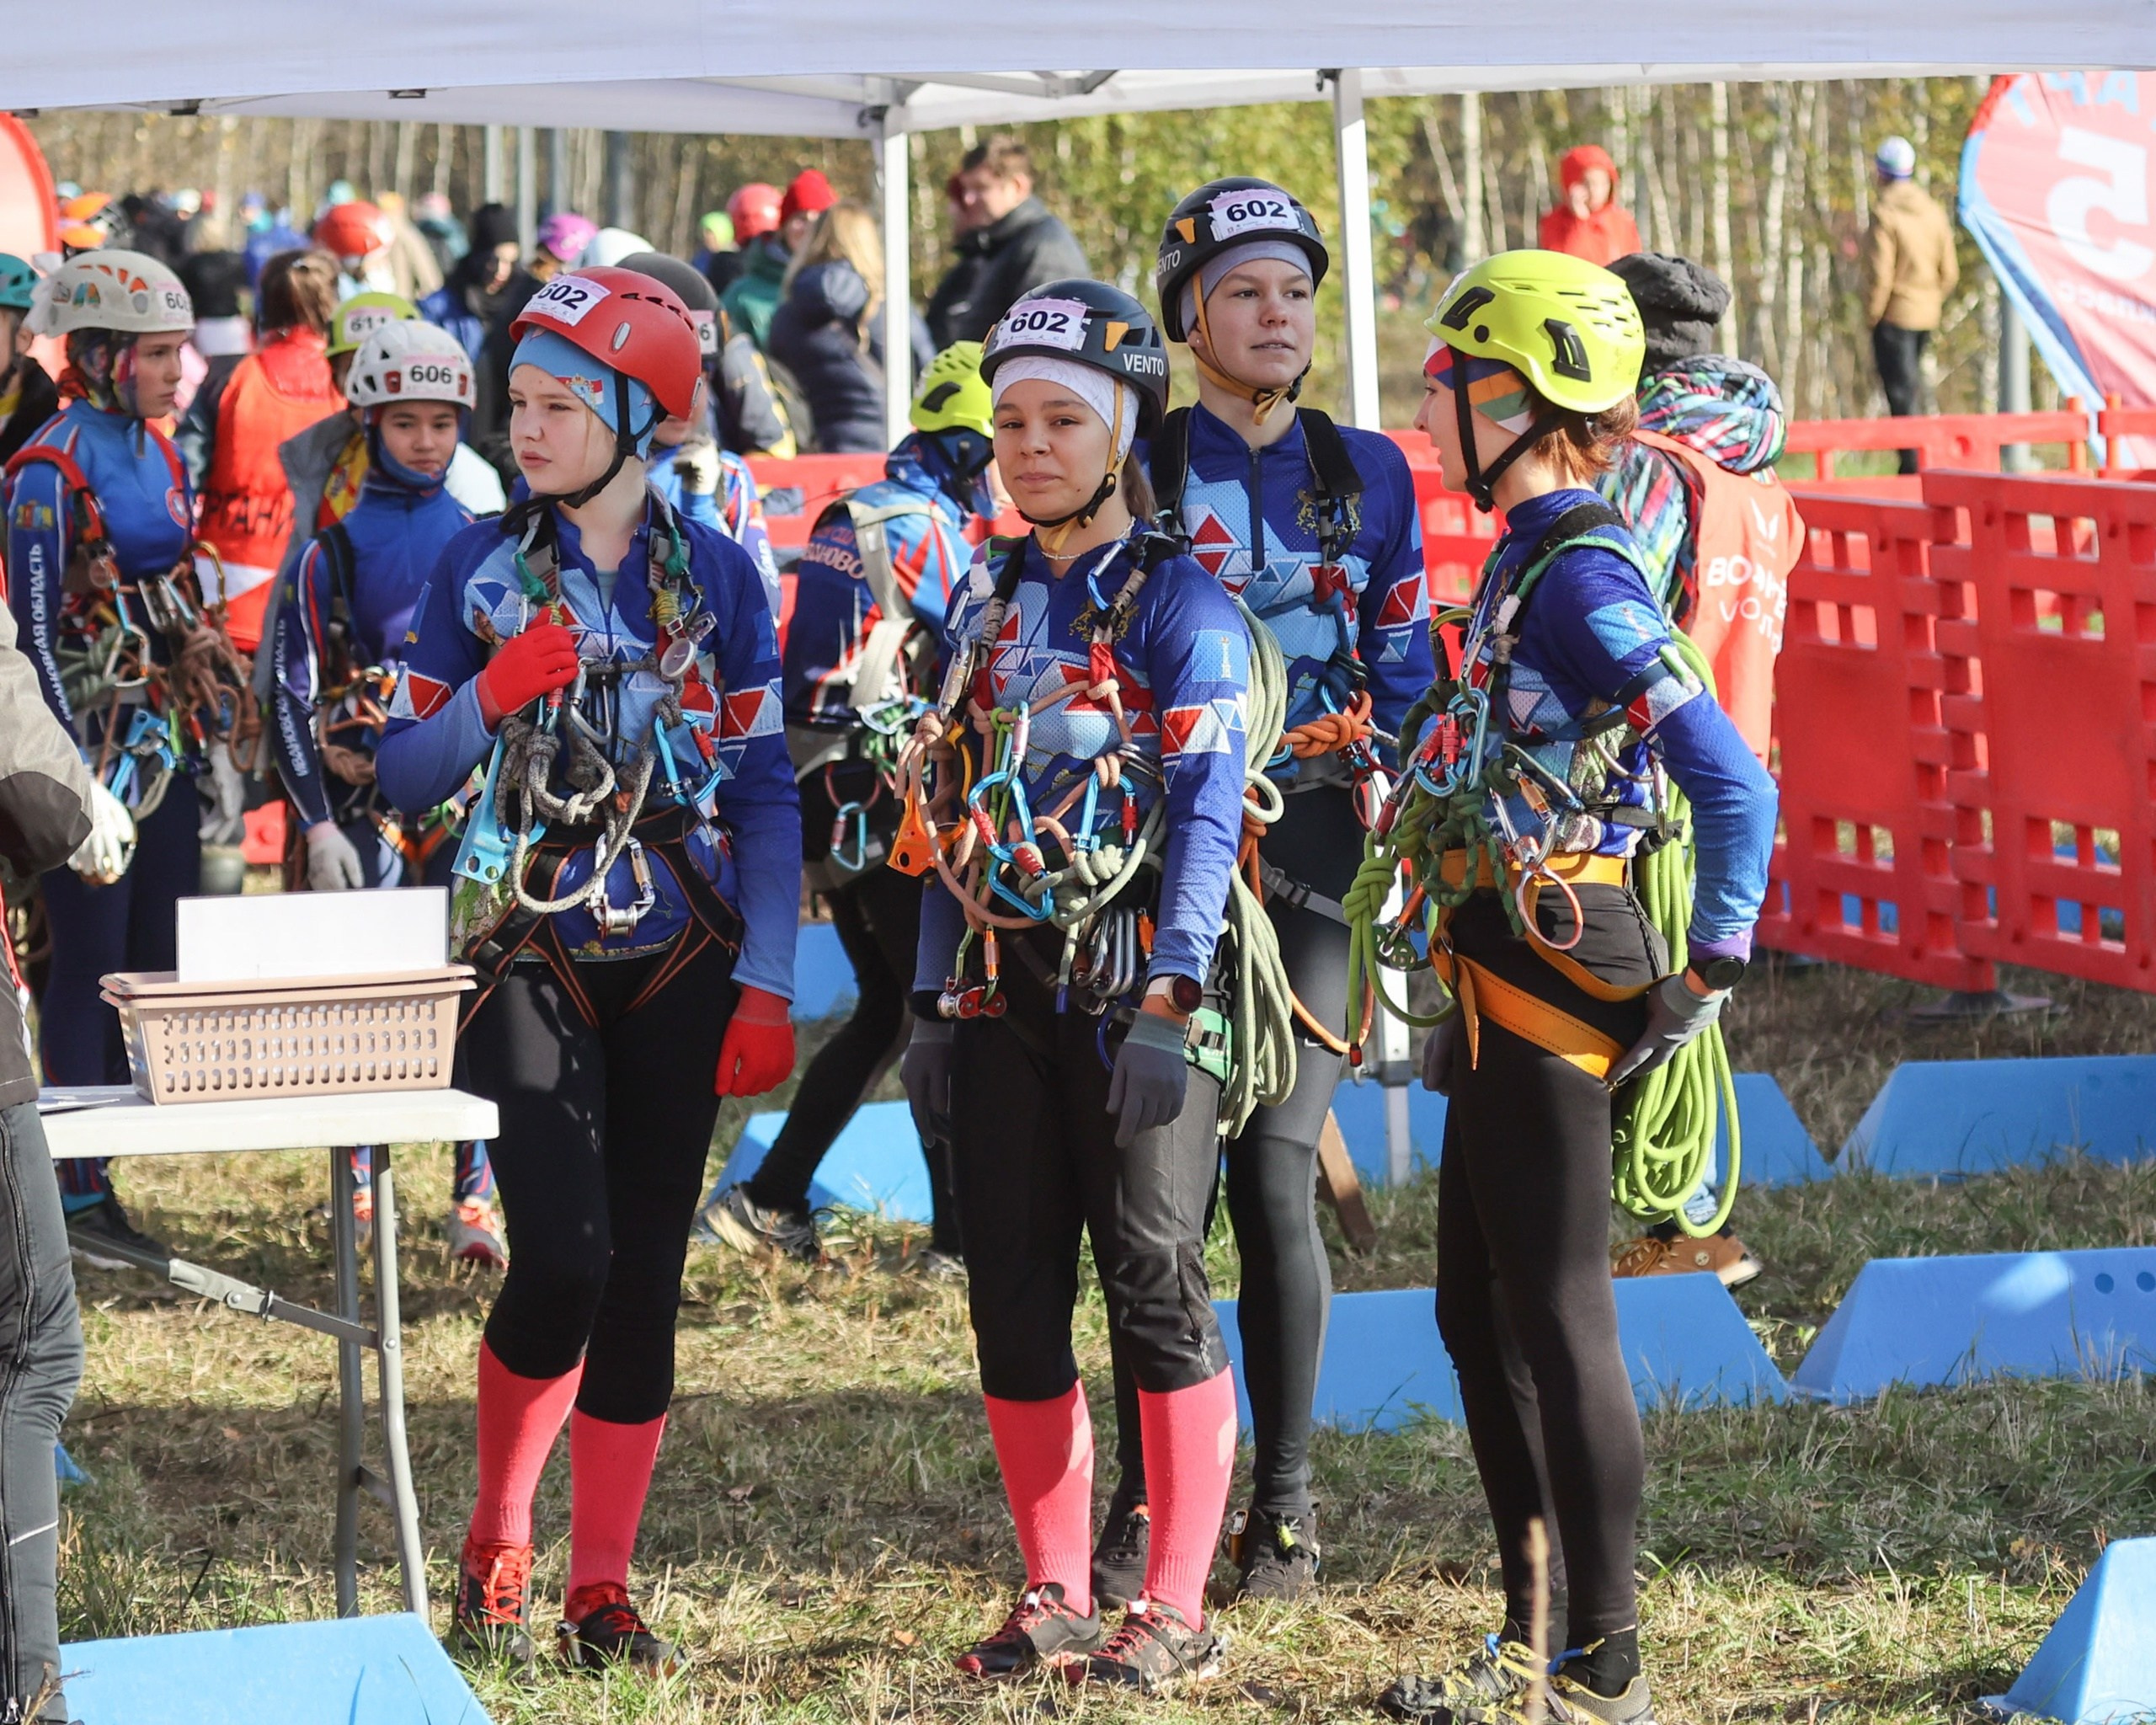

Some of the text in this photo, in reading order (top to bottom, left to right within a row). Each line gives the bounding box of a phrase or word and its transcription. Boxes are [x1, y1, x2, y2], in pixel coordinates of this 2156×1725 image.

[1226, 200, 1288, 222] 602
[1157, 249, 1181, 275] ENTO
[537, 282, 589, 311] 602
[1011, 310, 1070, 334] 602
[410, 366, 452, 384] 606
[1123, 353, 1165, 377] VENTO
[29, 543, 46, 622] ОБЛАСТЬ
